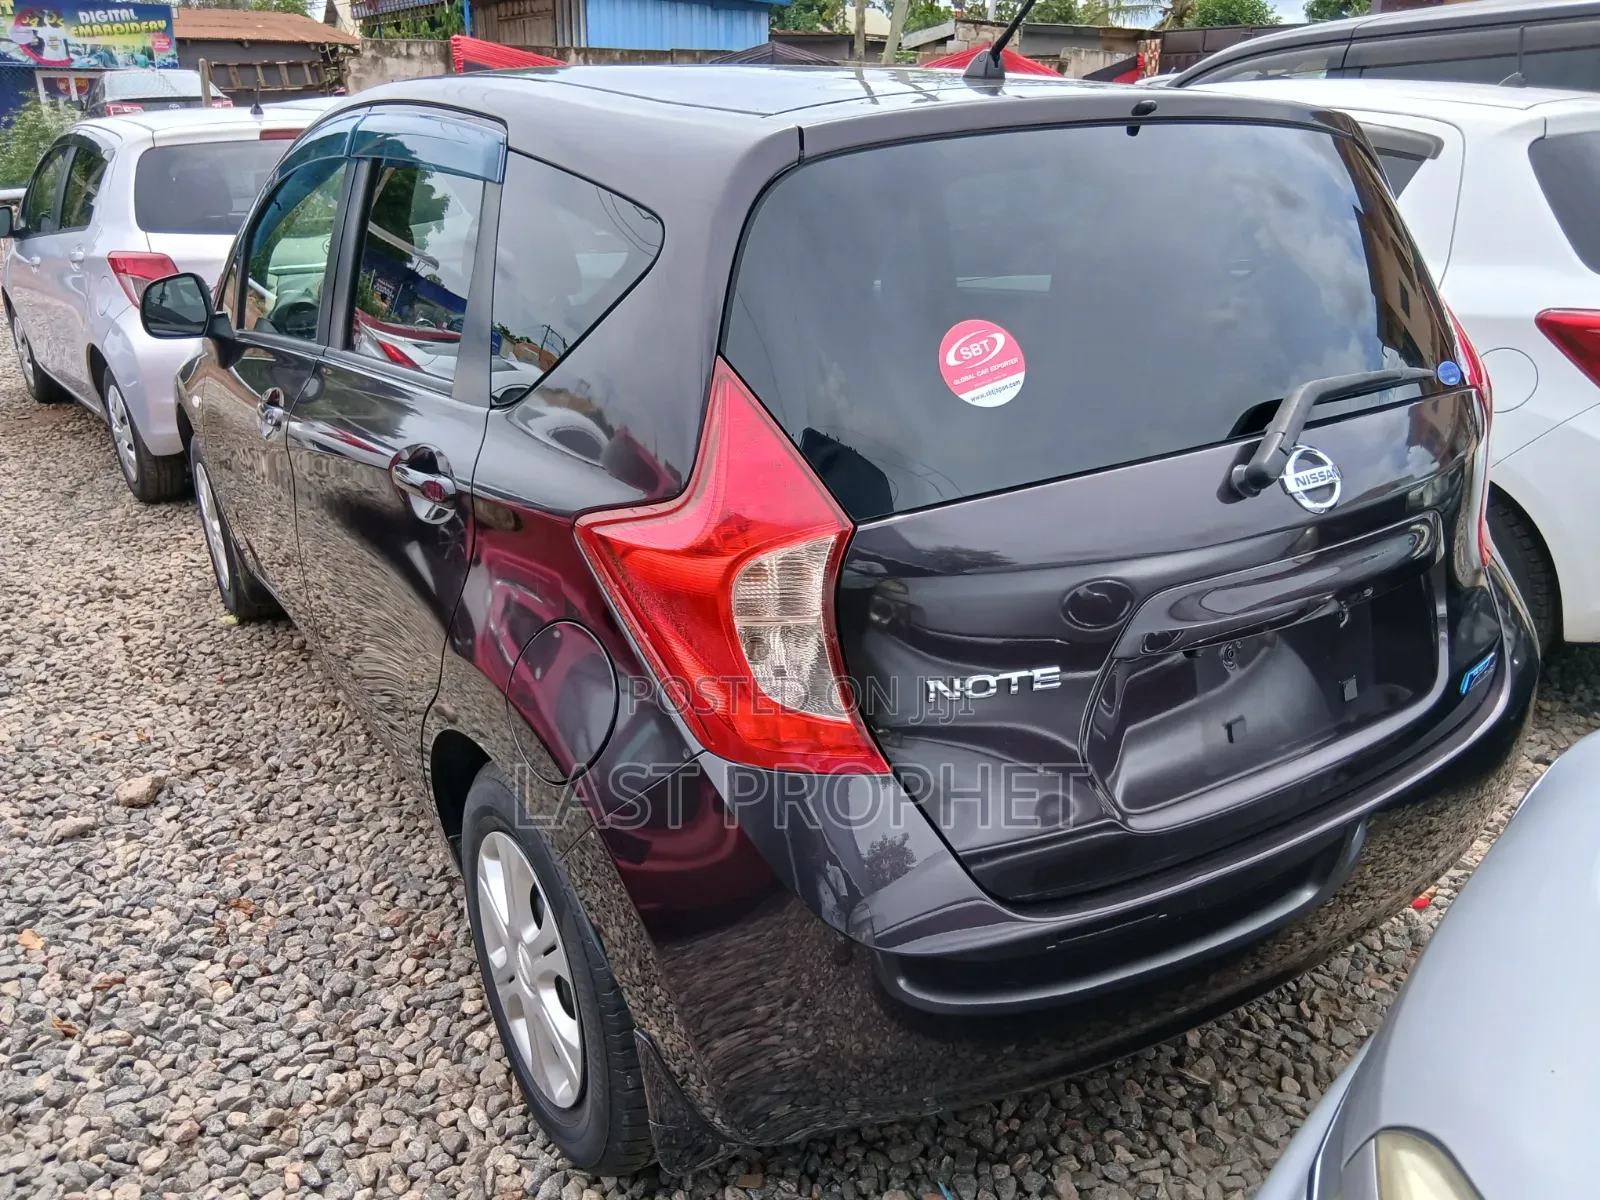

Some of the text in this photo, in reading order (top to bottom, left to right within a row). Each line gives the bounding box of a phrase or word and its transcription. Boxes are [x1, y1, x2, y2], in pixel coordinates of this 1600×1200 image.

[78, 8, 138, 24] DIGITAL
[70, 20, 167, 37] EMBROIDERY
[960, 339, 990, 360] SBT
[953, 374, 976, 386] GLOBAL
[976, 369, 989, 377] CAR
[989, 358, 1019, 372] EXPORTER
[1294, 468, 1341, 488] NISSAN
[926, 665, 1062, 703] NOTE
